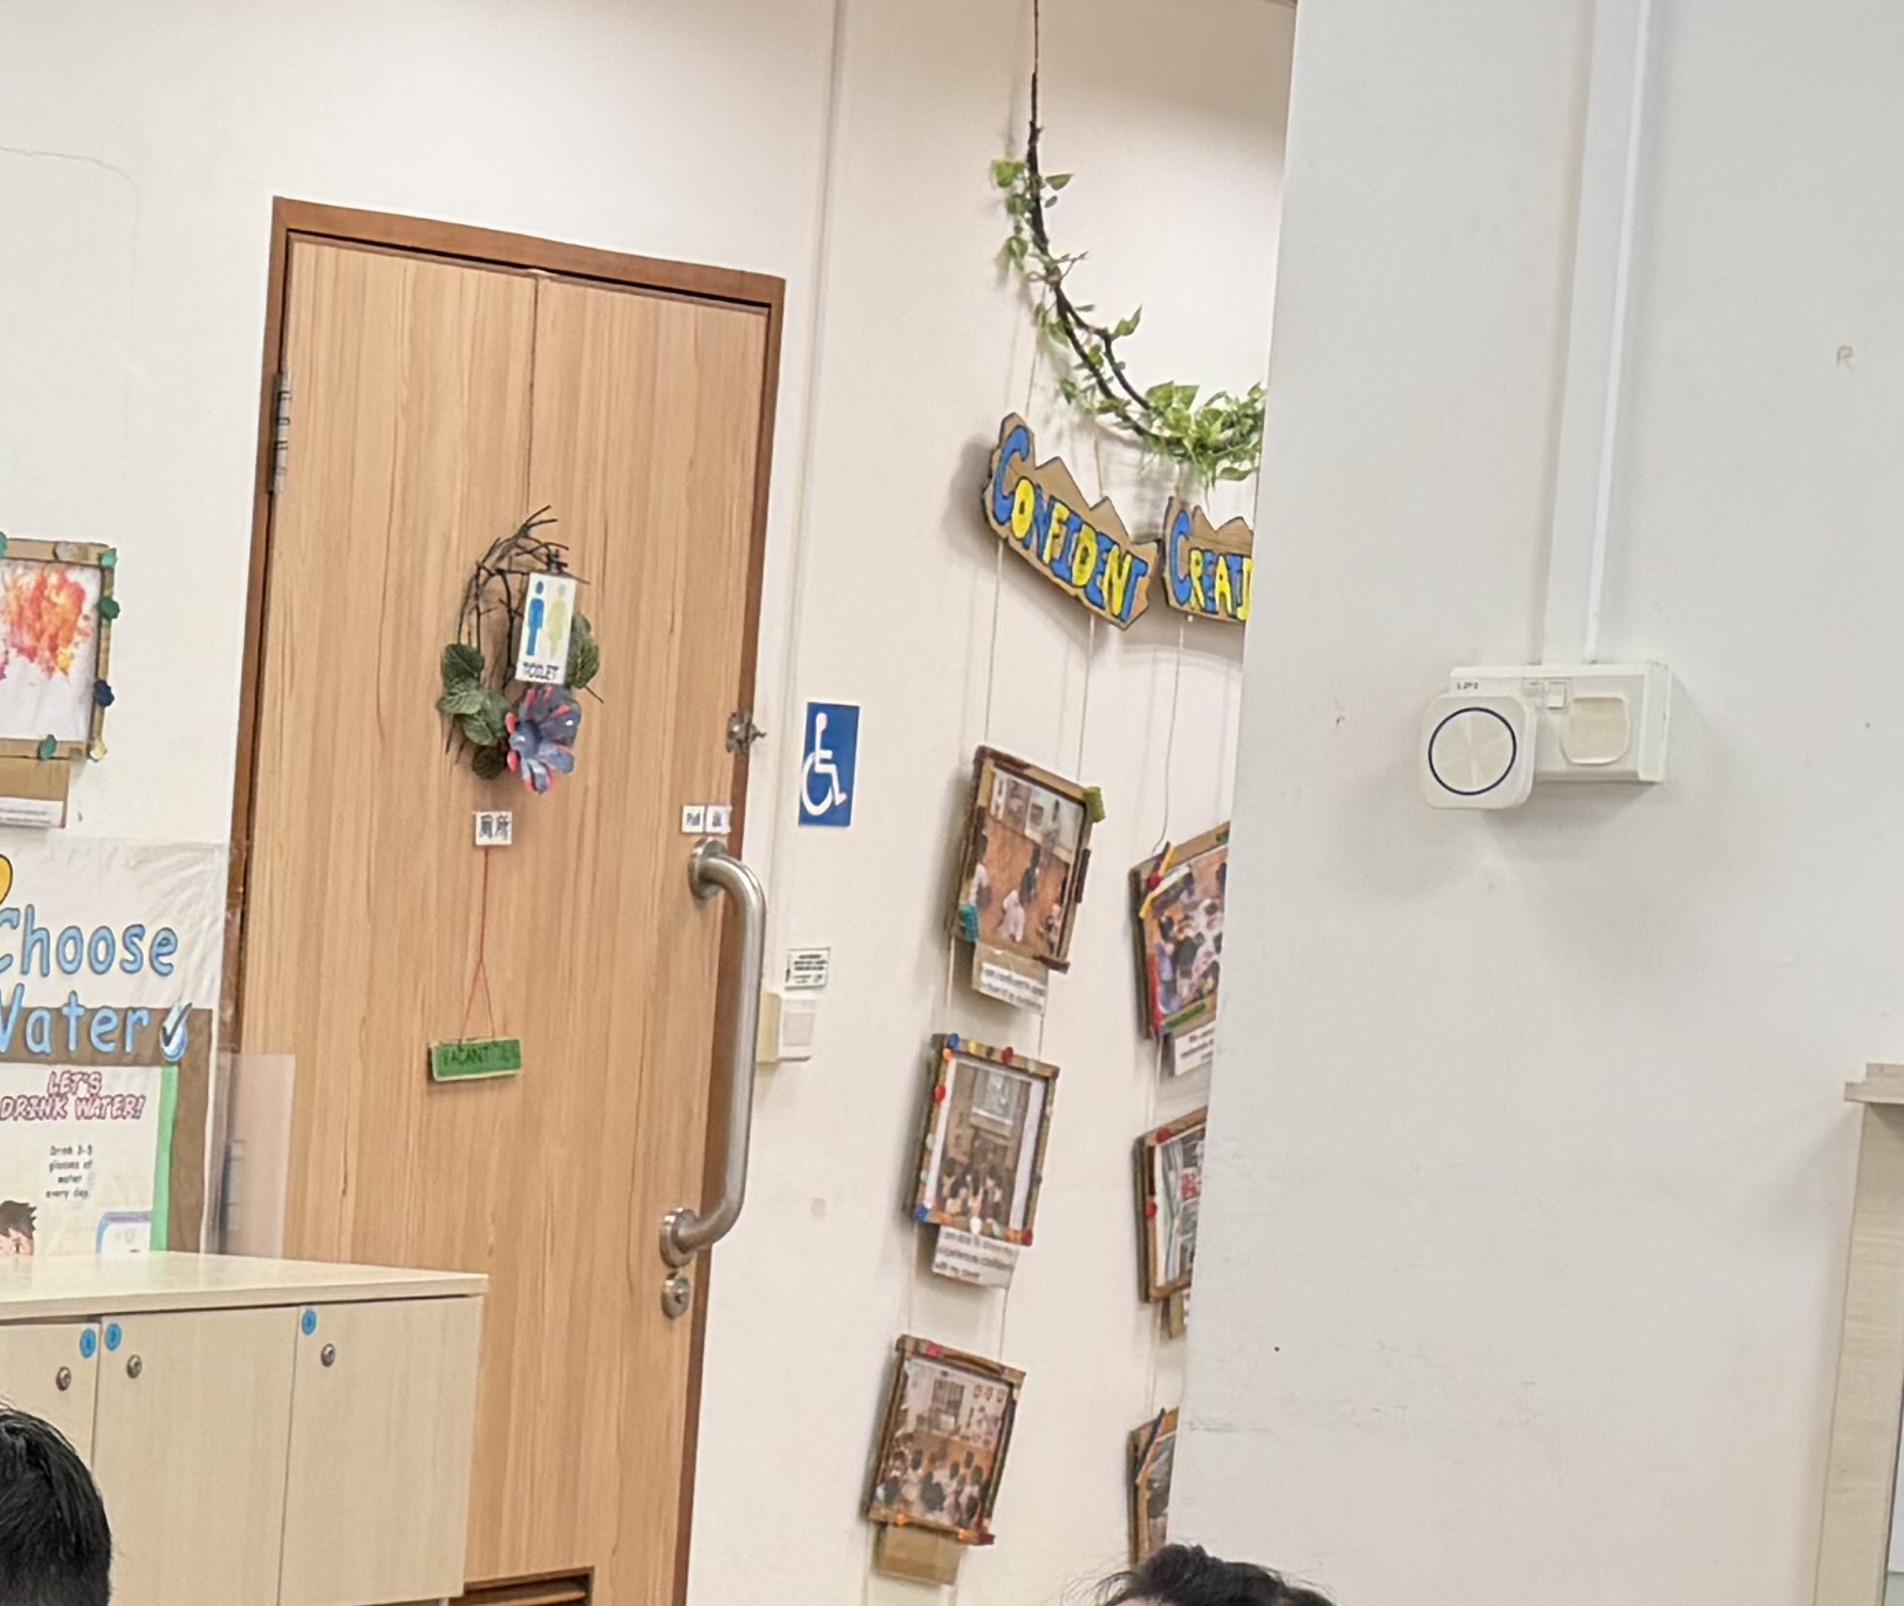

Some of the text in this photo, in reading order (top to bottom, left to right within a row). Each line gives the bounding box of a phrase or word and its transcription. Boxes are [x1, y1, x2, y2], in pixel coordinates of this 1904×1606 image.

[992, 424, 1150, 623] CONFIDENT
[47, 1070, 103, 1096] LET'S
[73, 1094, 147, 1121] WATER!
